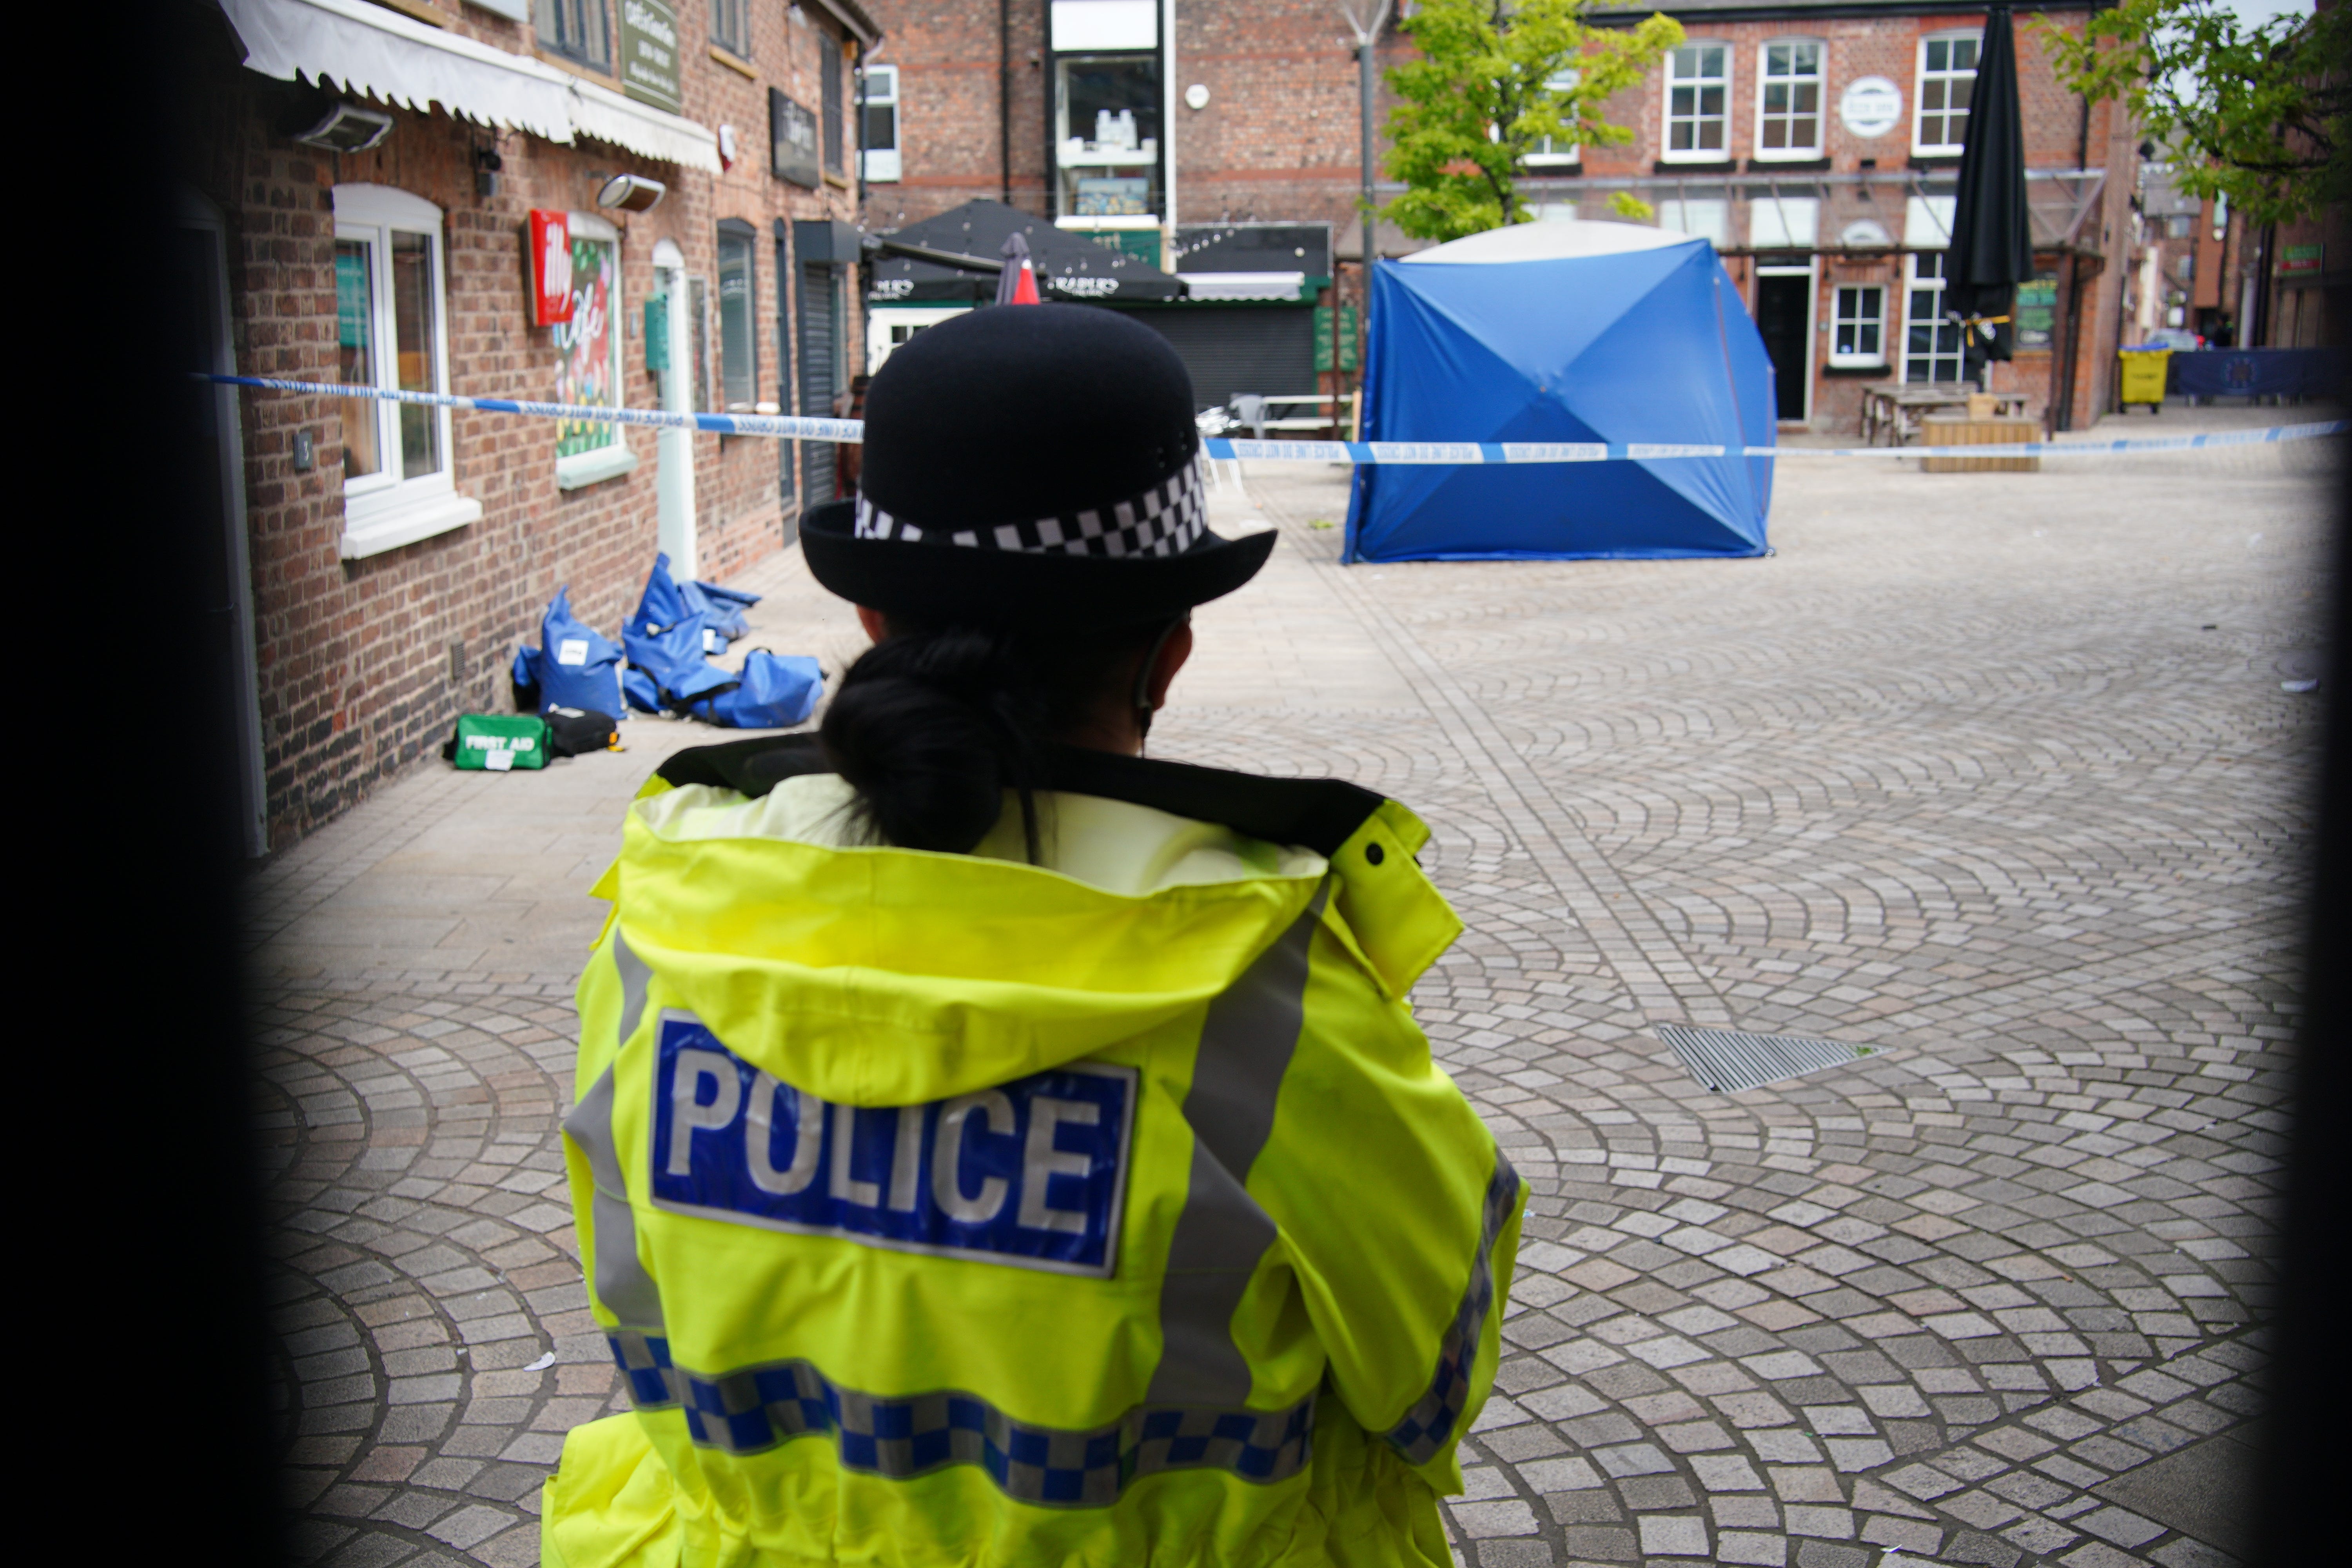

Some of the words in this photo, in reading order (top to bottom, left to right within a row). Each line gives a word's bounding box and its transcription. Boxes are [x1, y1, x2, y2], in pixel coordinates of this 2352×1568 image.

[465, 735, 507, 750] FIRST
[510, 737, 535, 751] AID
[666, 1047, 1099, 1235] POLICE
